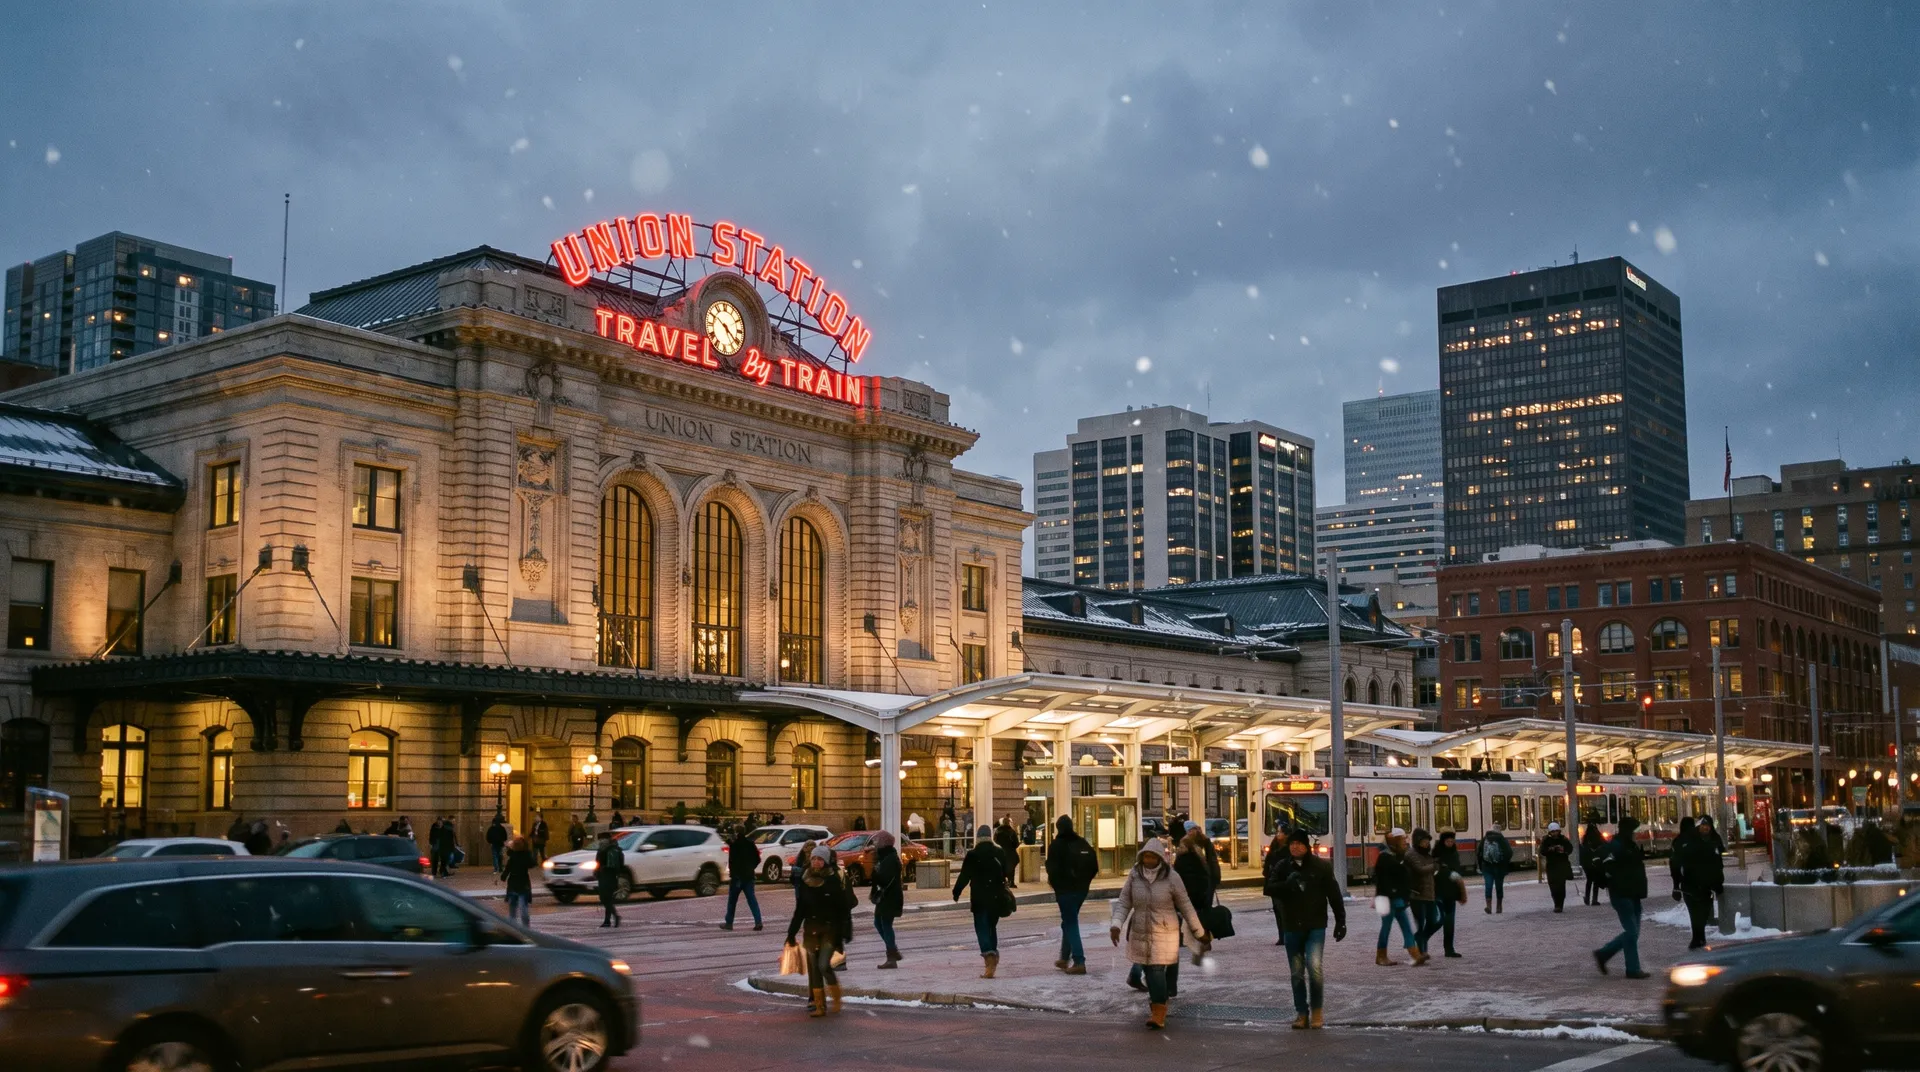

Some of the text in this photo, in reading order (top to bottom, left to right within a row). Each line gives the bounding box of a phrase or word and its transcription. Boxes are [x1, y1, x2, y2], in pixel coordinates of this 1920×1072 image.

[551, 212, 695, 286] UNION
[712, 221, 872, 363] STATION
[596, 309, 718, 368] TRAVEL
[743, 348, 772, 385] By
[780, 359, 862, 405] TRAIN
[645, 409, 812, 463] UNION STATION
